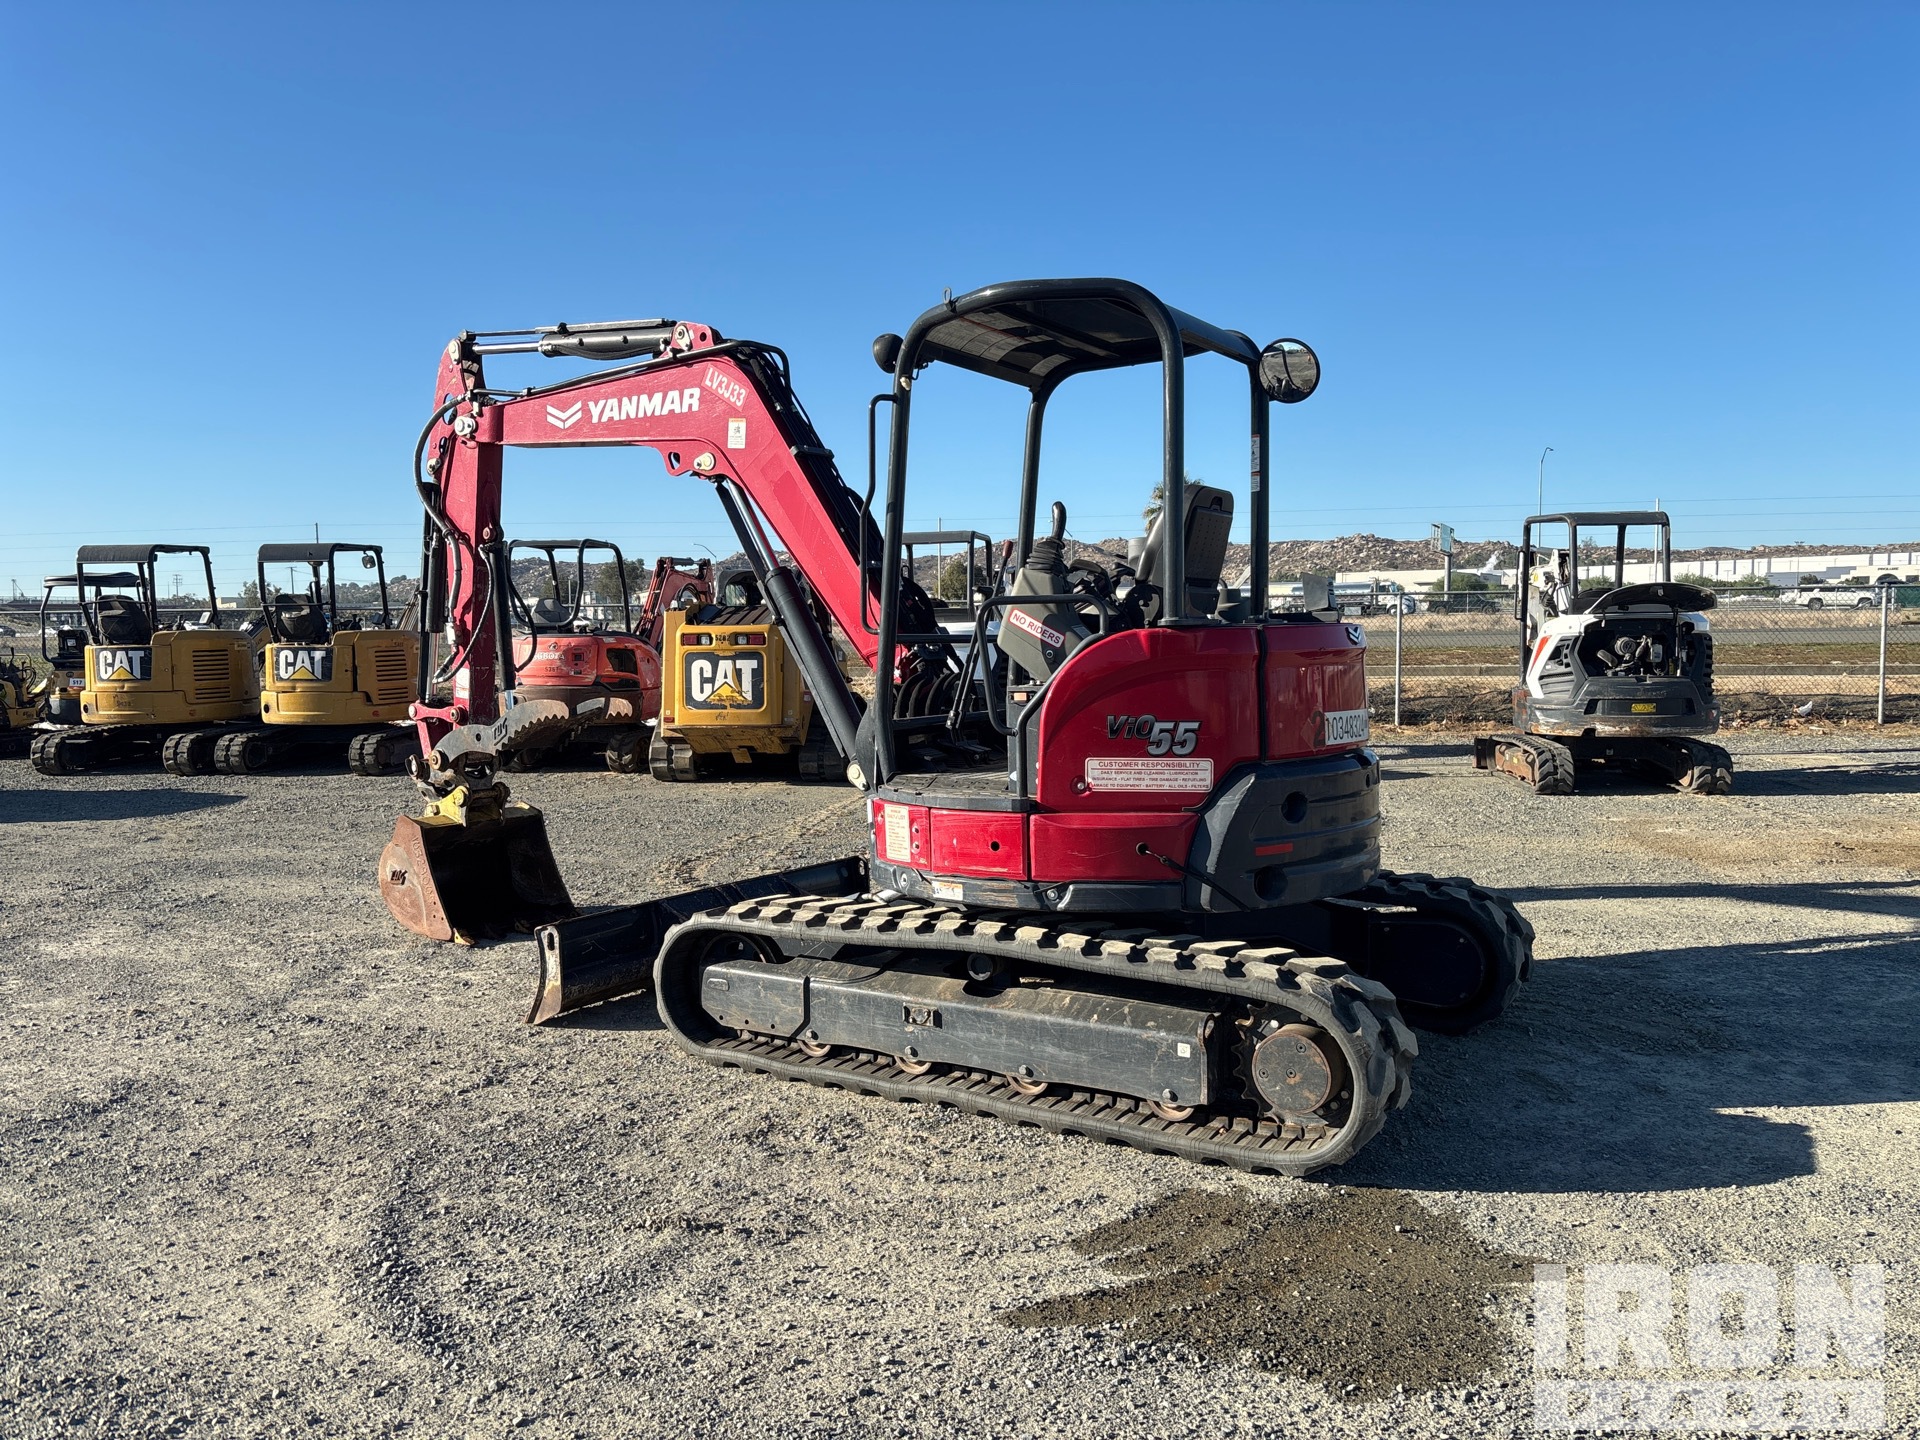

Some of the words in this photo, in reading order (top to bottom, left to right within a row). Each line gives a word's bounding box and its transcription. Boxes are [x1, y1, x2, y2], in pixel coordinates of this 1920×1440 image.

[704, 366, 746, 407] LV3J33
[587, 387, 701, 424] YANMAR
[1012, 612, 1027, 625] NO
[1026, 620, 1061, 644] RIDERS
[99, 650, 144, 680] CAT
[279, 649, 326, 680] CAT
[690, 659, 758, 702] CAT
[1147, 721, 1201, 757] 55
